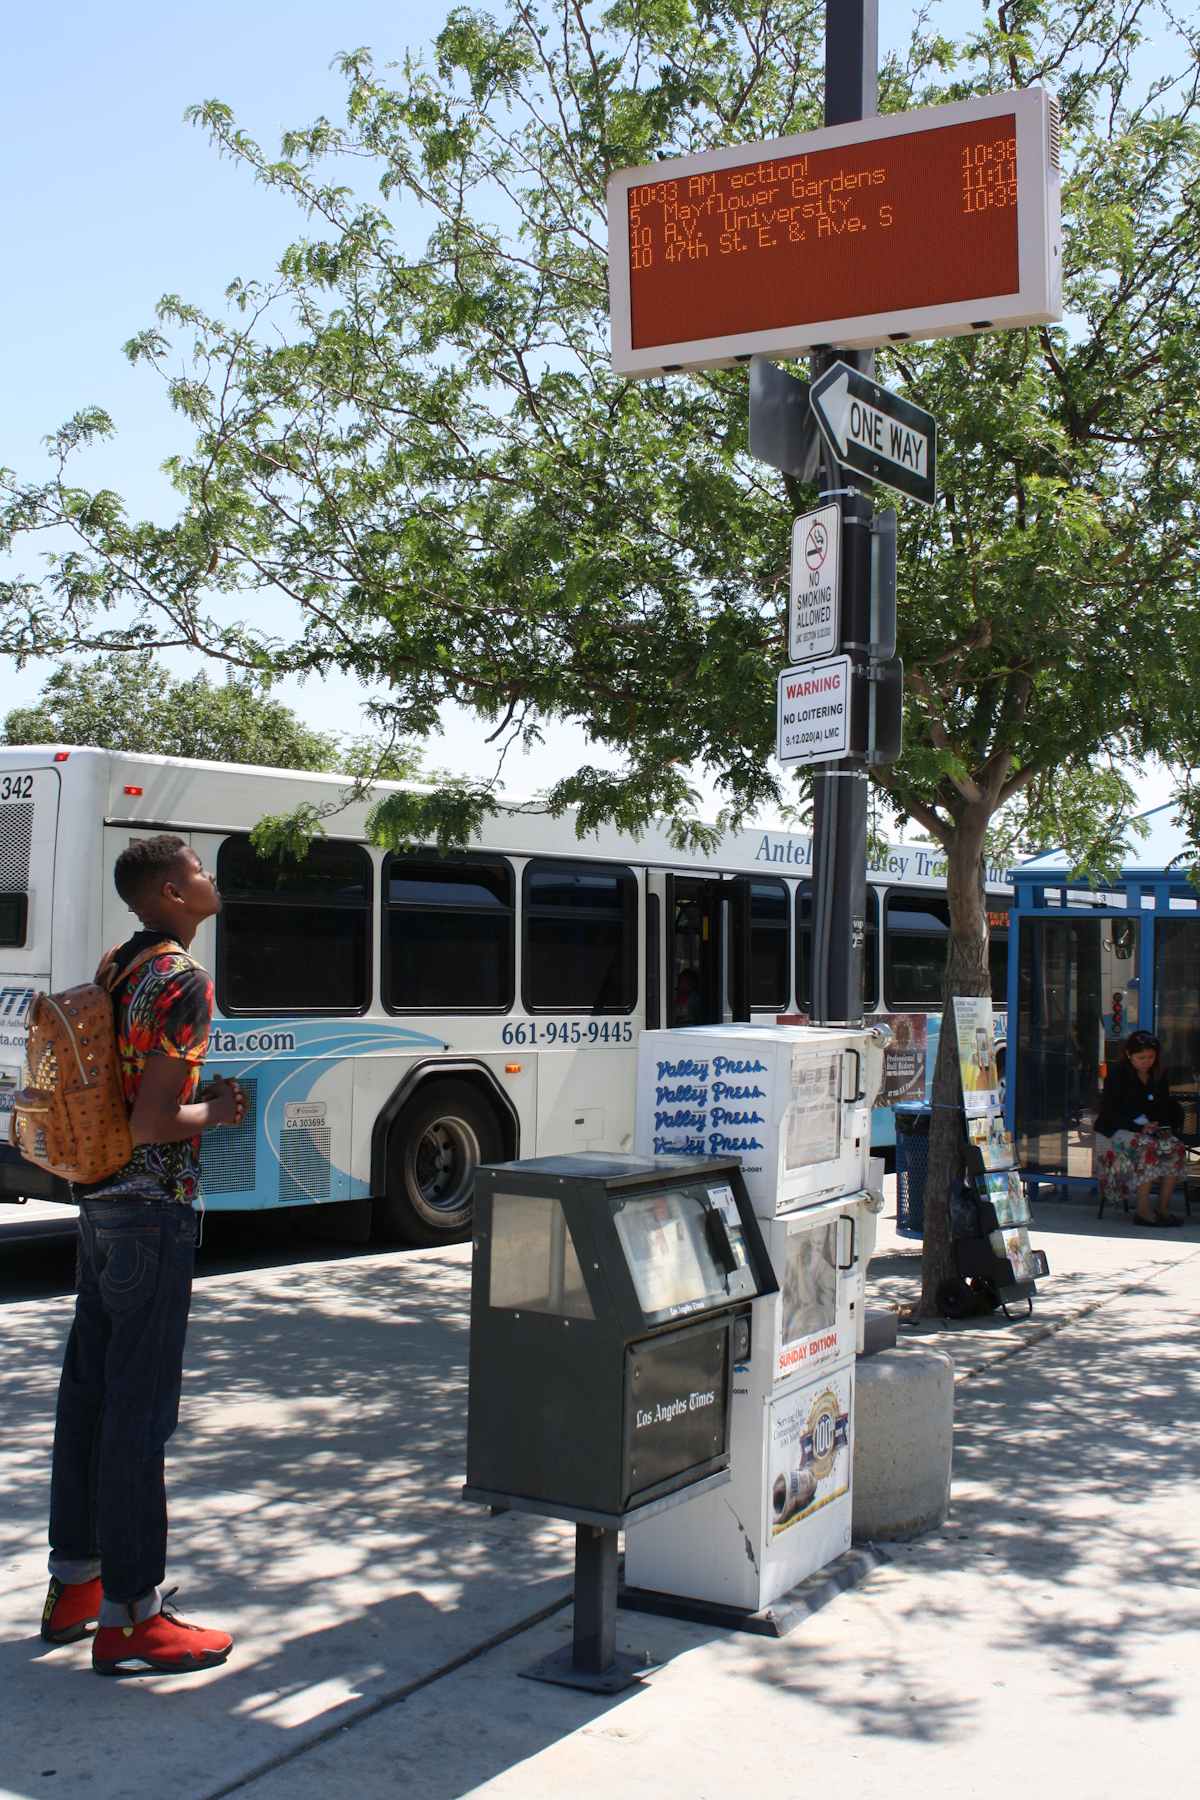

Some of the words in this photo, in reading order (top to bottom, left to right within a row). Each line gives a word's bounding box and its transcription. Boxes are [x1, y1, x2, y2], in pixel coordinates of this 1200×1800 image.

[630, 208, 641, 228] 5
[664, 189, 780, 222] Mayflower
[792, 169, 886, 199] Gardens
[962, 139, 1017, 169] 10:38
[630, 181, 677, 208] 10:33
[689, 173, 716, 197] AM
[631, 227, 652, 249] 10
[665, 218, 703, 243] A.V.
[725, 194, 852, 232] University
[962, 161, 1018, 191] 11:11
[631, 247, 652, 269] 10
[665, 240, 709, 262] 47th
[720, 232, 747, 254] St.
[759, 226, 777, 248] E.
[789, 221, 806, 242] &
[818, 216, 867, 238] Ave.
[879, 205, 893, 227] S
[963, 184, 1019, 213] 10:39
[850, 402, 883, 452] ONE
[890, 422, 923, 470] WAY
[809, 570, 820, 588] NO
[797, 586, 831, 610] SMOKING
[797, 605, 831, 630] ALLOWED
[803, 630, 816, 642] SECTION
[786, 674, 841, 700] WARNING
[783, 713, 796, 725] NO
[797, 703, 843, 722] LOITERING
[785, 730, 822, 746] 9.12.020(A)
[824, 727, 840, 739] LMC
[502, 1022, 633, 1045] 661-945-9445
[656, 1059, 709, 1082] Valley
[713, 1056, 768, 1077] Press
[887, 1054, 915, 1062] Professional
[887, 1062, 897, 1070] Bull
[898, 1061, 915, 1070] Riders
[655, 1084, 708, 1107] Valley
[711, 1082, 767, 1103] Press
[287, 1119, 298, 1128] CA
[300, 1118, 325, 1128] 303695
[654, 1110, 706, 1133] Valley
[710, 1107, 765, 1128] Press
[709, 1133, 764, 1154] Press
[779, 1344, 807, 1369] SUNDAY
[809, 1333, 836, 1356] EDITION
[636, 1409, 652, 1429] Los
[653, 1398, 687, 1422] Angeles
[689, 1390, 714, 1411] Times
[777, 1412, 795, 1429] Serving
[795, 1409, 803, 1418] Our
[773, 1421, 800, 1440] Community
[780, 1437, 789, 1448] 100
